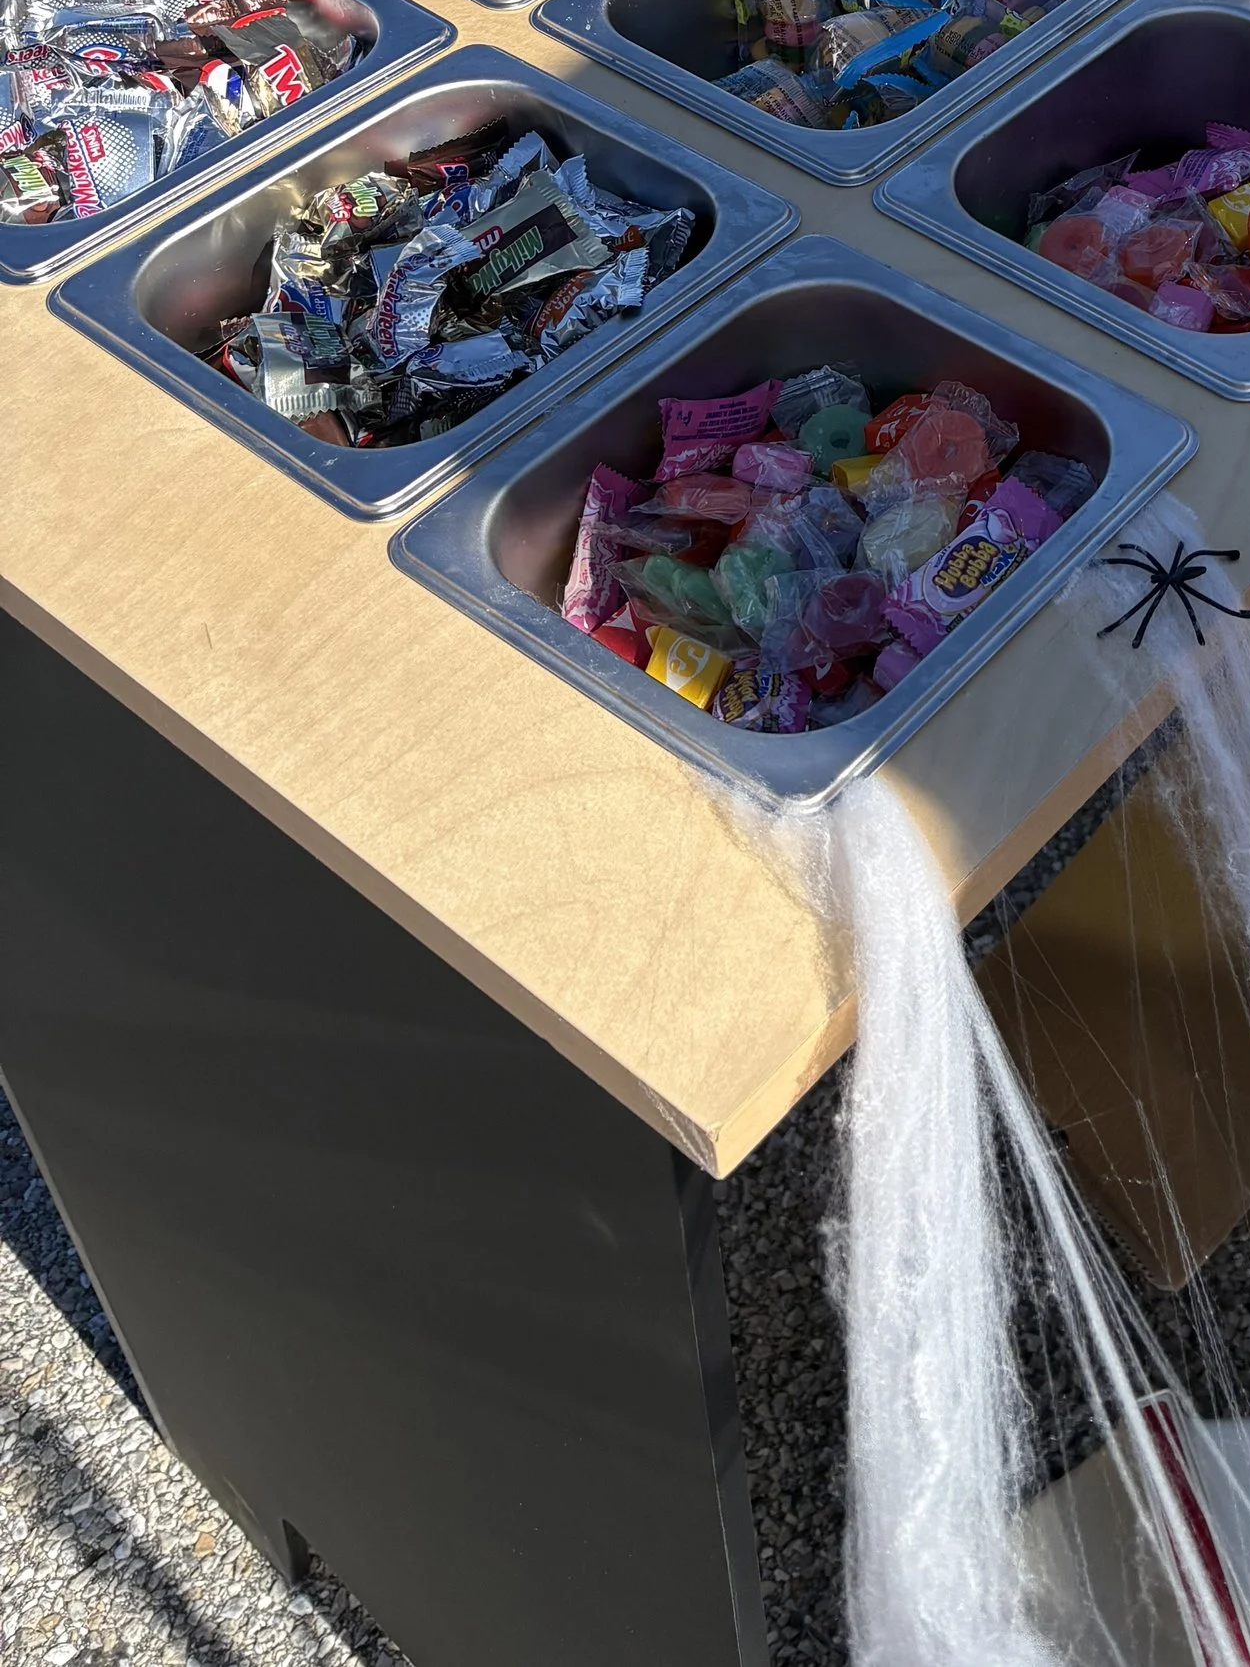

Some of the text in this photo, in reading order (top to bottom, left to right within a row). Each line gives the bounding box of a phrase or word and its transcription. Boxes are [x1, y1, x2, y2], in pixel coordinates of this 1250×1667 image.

[82, 124, 105, 161] MINIS
[934, 543, 976, 591] Hubba
[961, 540, 1000, 589] Bubba
